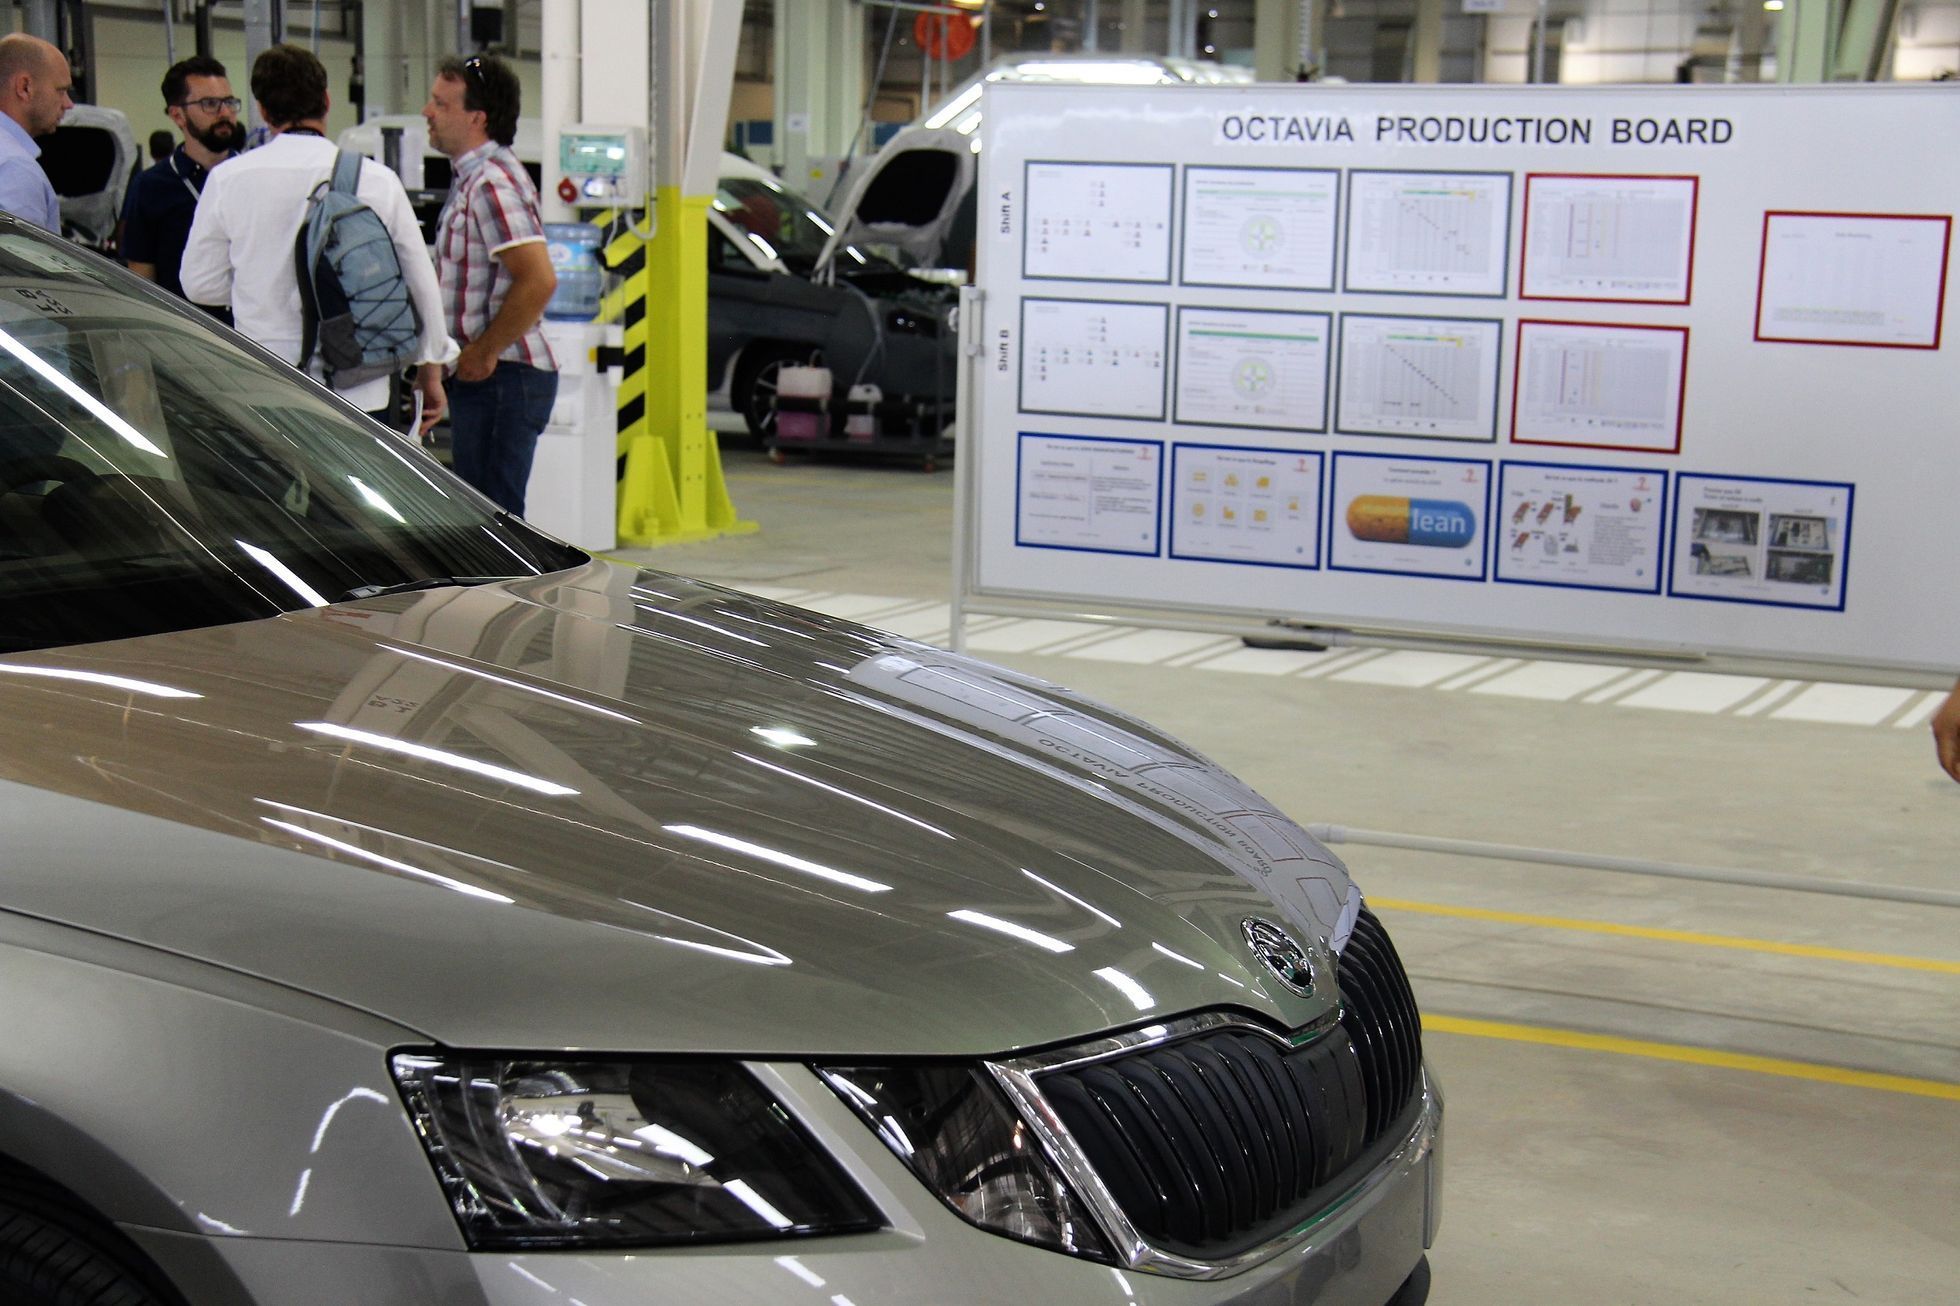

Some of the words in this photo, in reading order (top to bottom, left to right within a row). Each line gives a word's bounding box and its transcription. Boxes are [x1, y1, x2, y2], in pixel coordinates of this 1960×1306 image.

[1222, 116, 1353, 141] OCTAVIA
[1376, 117, 1591, 143] PRODUCTION
[1612, 118, 1733, 143] BOARD
[1001, 191, 1011, 201] A
[1000, 204, 1011, 234] Shift
[999, 329, 1009, 338] B
[998, 343, 1009, 371] Shift
[1412, 508, 1466, 534] lean
